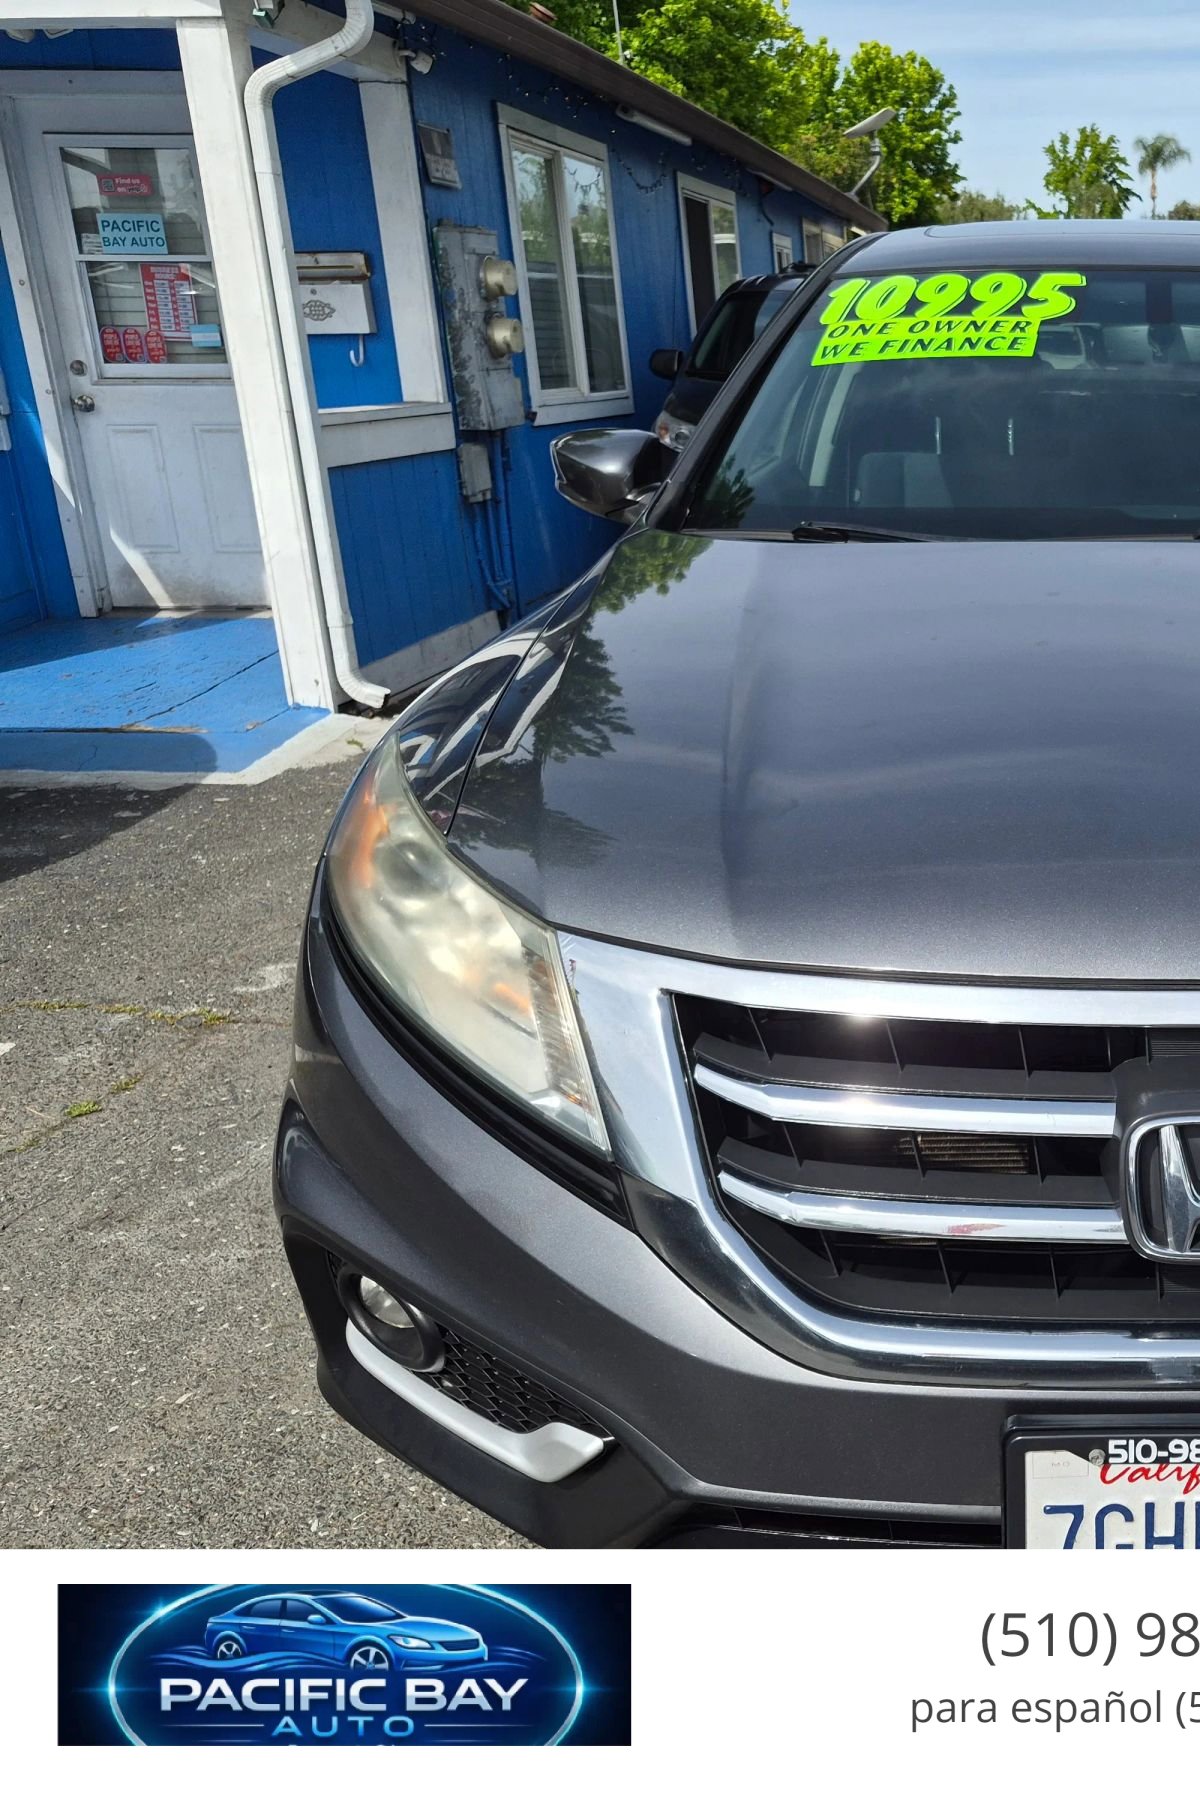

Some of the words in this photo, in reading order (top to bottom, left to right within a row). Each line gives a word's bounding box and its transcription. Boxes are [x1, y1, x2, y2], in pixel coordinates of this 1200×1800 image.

[101, 220, 160, 232] PACIFIC
[102, 236, 127, 248] BAY
[131, 236, 165, 248] AUTO
[819, 272, 1087, 324] 10995
[827, 321, 897, 339] ONE
[908, 320, 1033, 335] OWNER
[820, 341, 872, 360] WE
[878, 336, 1028, 355] FINANCE
